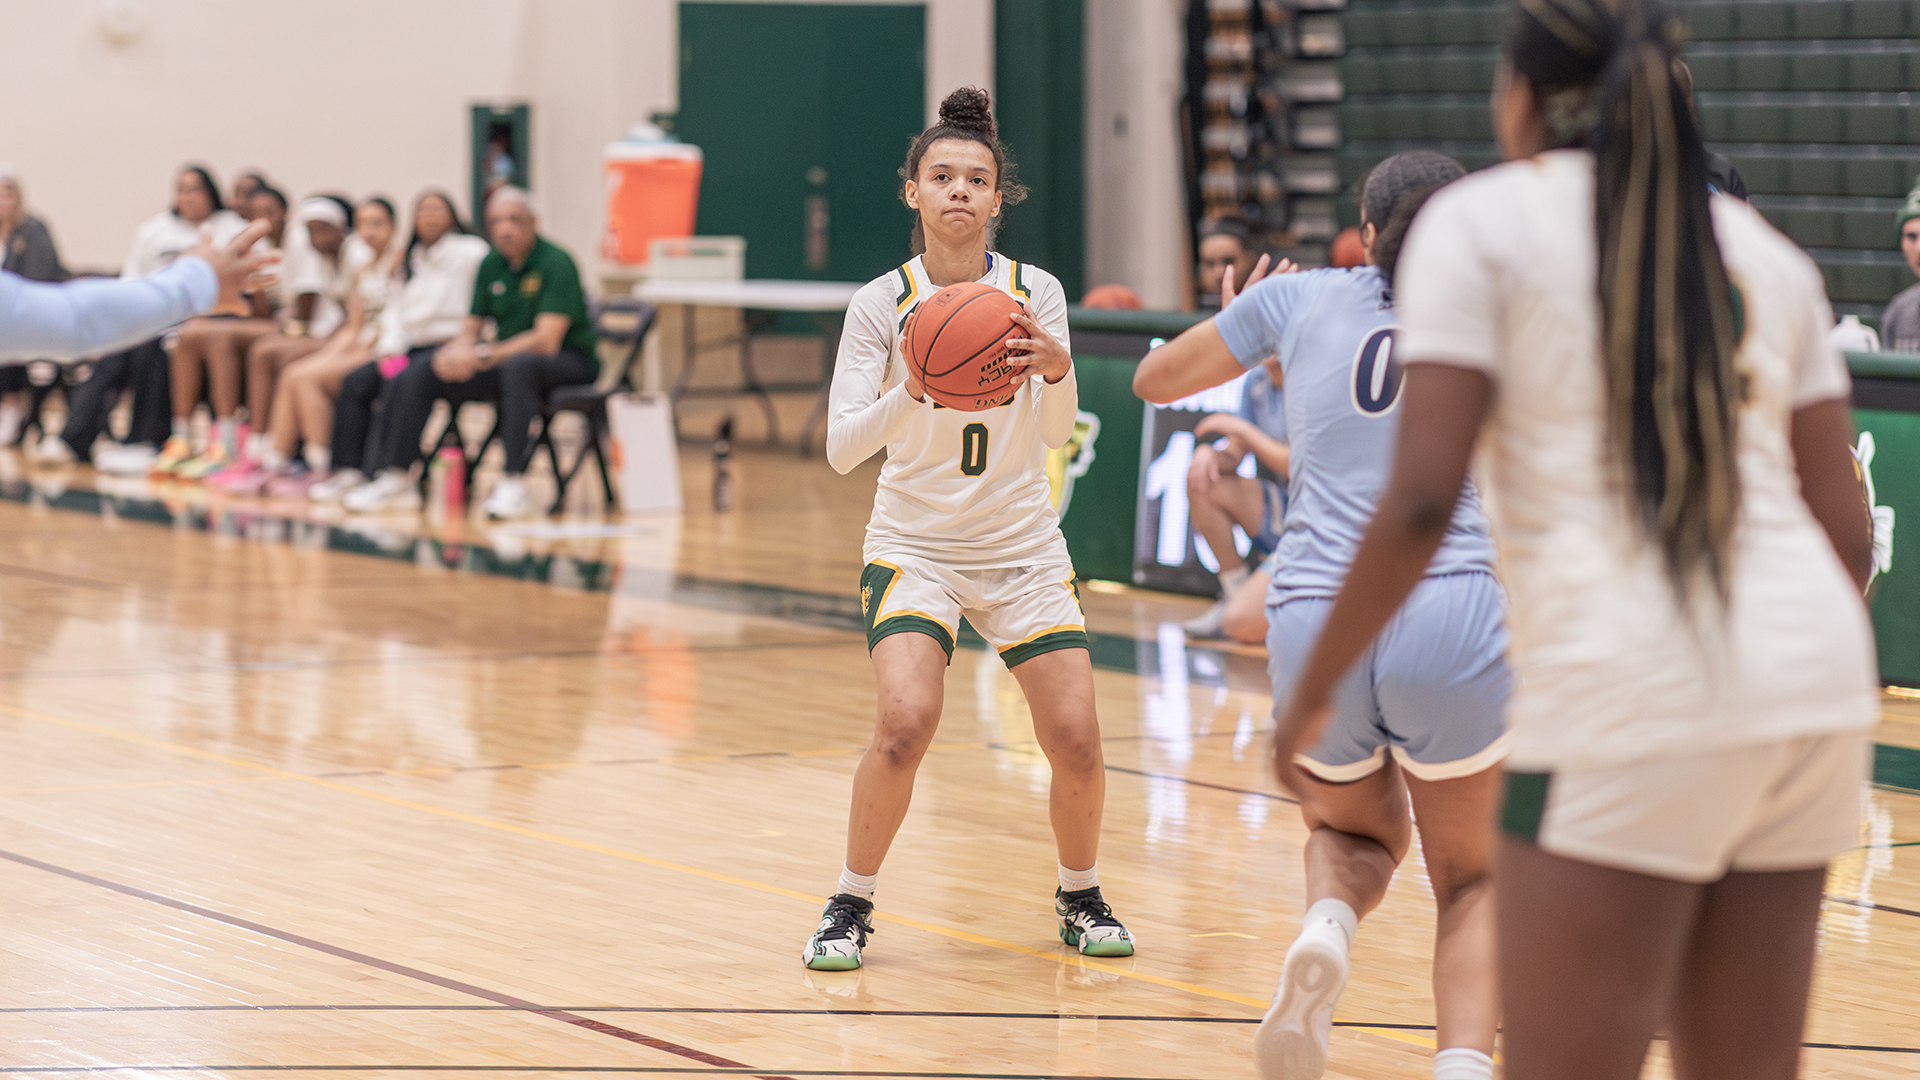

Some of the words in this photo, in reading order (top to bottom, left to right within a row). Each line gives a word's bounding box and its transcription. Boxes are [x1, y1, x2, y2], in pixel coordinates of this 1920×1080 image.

[978, 365, 1015, 387] ACY
[1350, 324, 1407, 418] 0
[959, 421, 989, 477] 0
